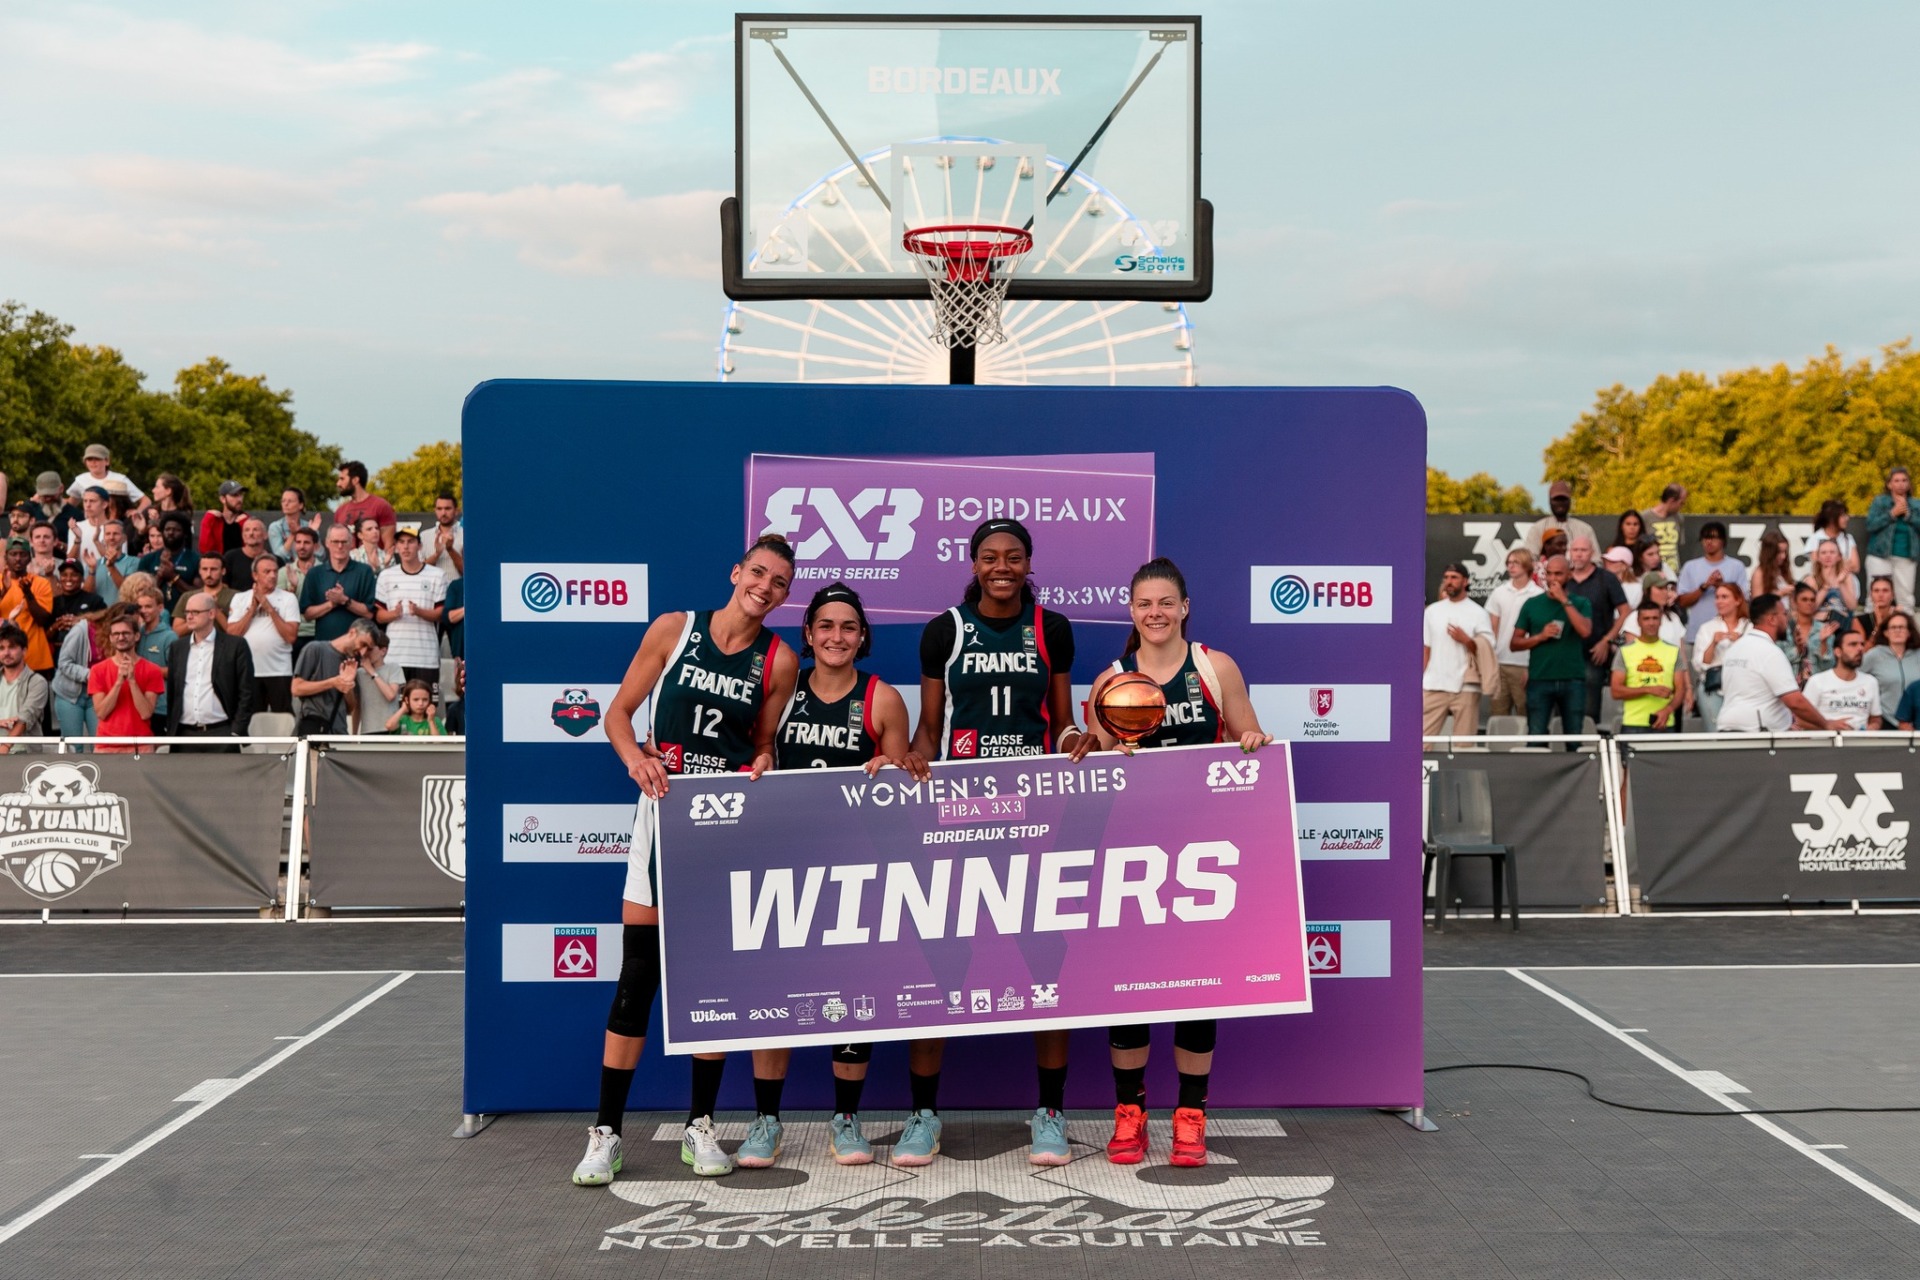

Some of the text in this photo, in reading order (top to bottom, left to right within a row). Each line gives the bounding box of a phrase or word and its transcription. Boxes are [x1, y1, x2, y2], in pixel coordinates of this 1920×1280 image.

[867, 66, 1062, 95] BORDEAUX
[1137, 264, 1185, 272] Sports
[937, 497, 1127, 522] BORDEAUX
[936, 537, 970, 562] ST
[795, 567, 900, 580] MEN'S SERIES
[566, 579, 629, 607] FFBB
[1038, 586, 1131, 605] #3x3WS
[1313, 581, 1373, 608] FFBB
[962, 652, 1039, 674] FRANCE
[677, 663, 756, 705] FRANCE
[990, 685, 1012, 716] 11
[692, 704, 724, 739] 12
[1162, 701, 1207, 727] NCE
[1303, 721, 1340, 729] Nouvelle-
[1303, 729, 1340, 738] Aquitaine
[784, 722, 862, 752] FRANCE
[980, 735, 1024, 746] CAISSE
[683, 752, 727, 769] CAISSE
[840, 766, 1128, 808] WOMEN'S SERIES
[941, 803, 983, 819] FIBA
[11, 836, 99, 848] BASKETBALL CLUB
[509, 832, 632, 844] NOUVELLE-AQUITAI
[922, 823, 1050, 845] BORDEAUX STOP
[1297, 828, 1384, 840] LLE-AQUITAINE
[577, 842, 630, 854] basketba
[1320, 837, 1384, 851] basketball
[1798, 837, 1908, 862] basketball
[1798, 859, 1907, 872] NOUVELLE-AQUITAINE
[729, 839, 1240, 950] WINNERS
[555, 928, 596, 936] BORDEAUX
[1113, 977, 1223, 992] WS.FIBA3x3.BASKETBALL
[1245, 973, 1281, 983] #3x3WS
[896, 999, 944, 1008] GOUVERNEMENT
[690, 1009, 736, 1023] Wilson
[598, 1230, 1328, 1250] NOUVELLE-AQUITAINE
